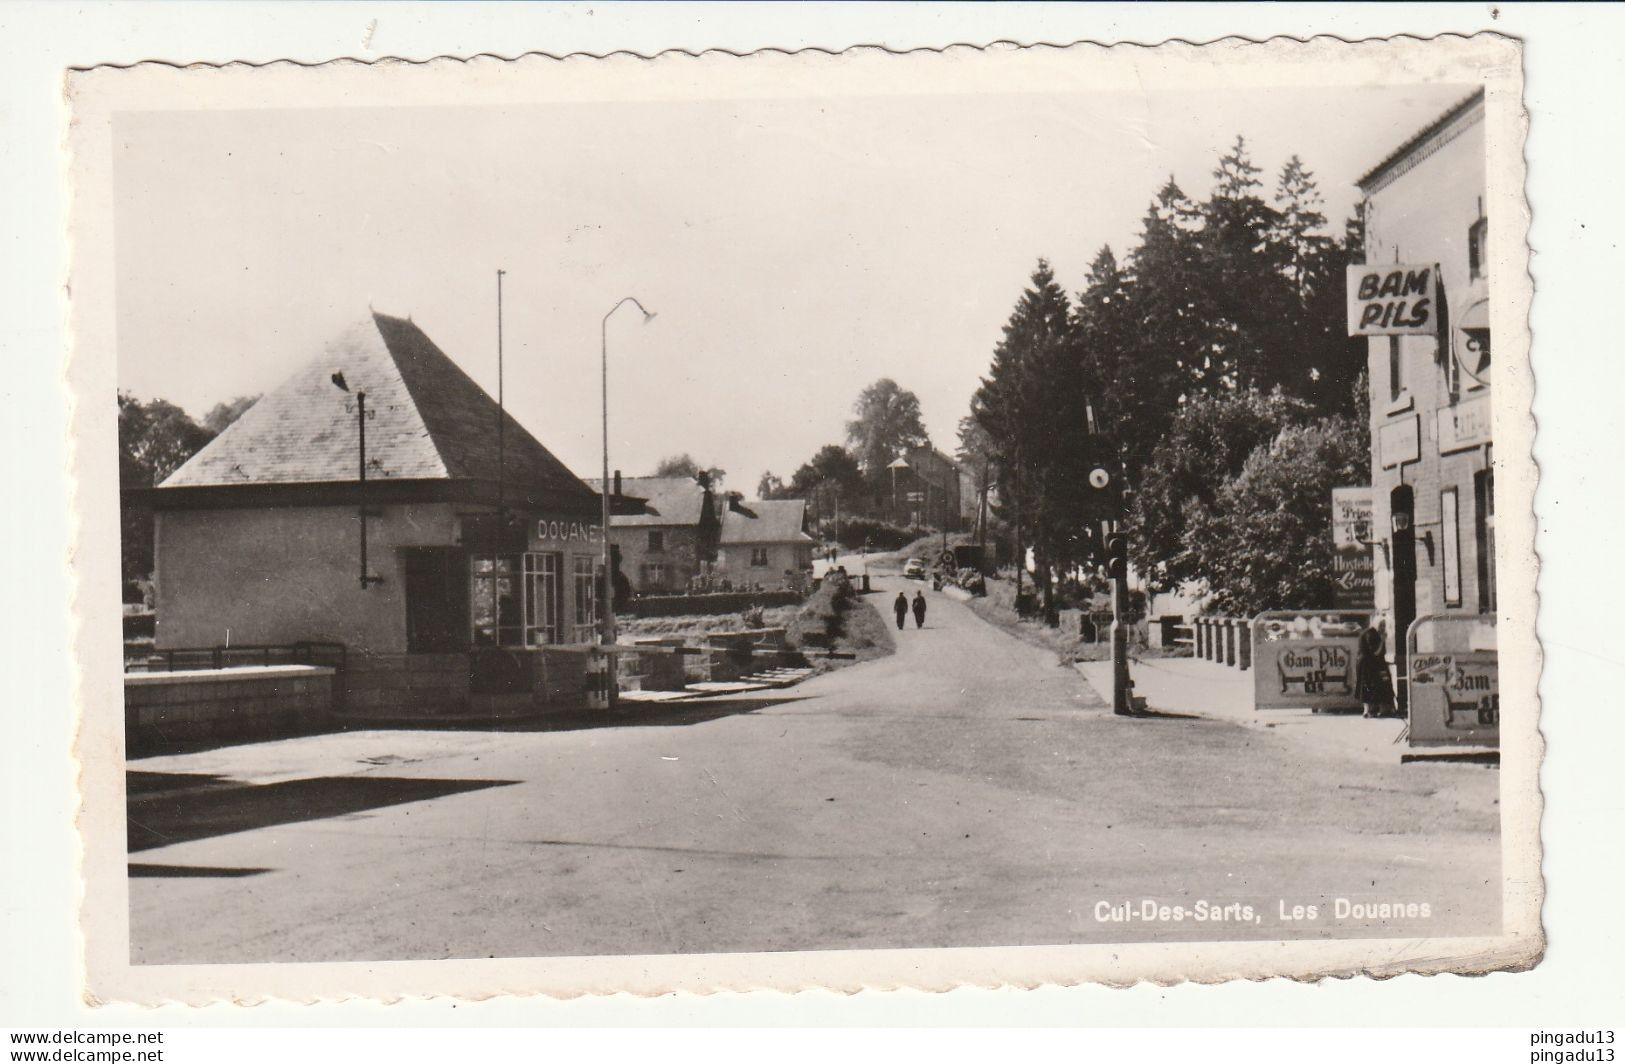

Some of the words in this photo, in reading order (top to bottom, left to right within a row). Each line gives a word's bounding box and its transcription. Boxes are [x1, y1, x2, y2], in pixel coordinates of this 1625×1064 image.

[1358, 268, 1430, 300] BAM
[1359, 298, 1430, 329] PILS
[538, 519, 598, 543] DOUANE
